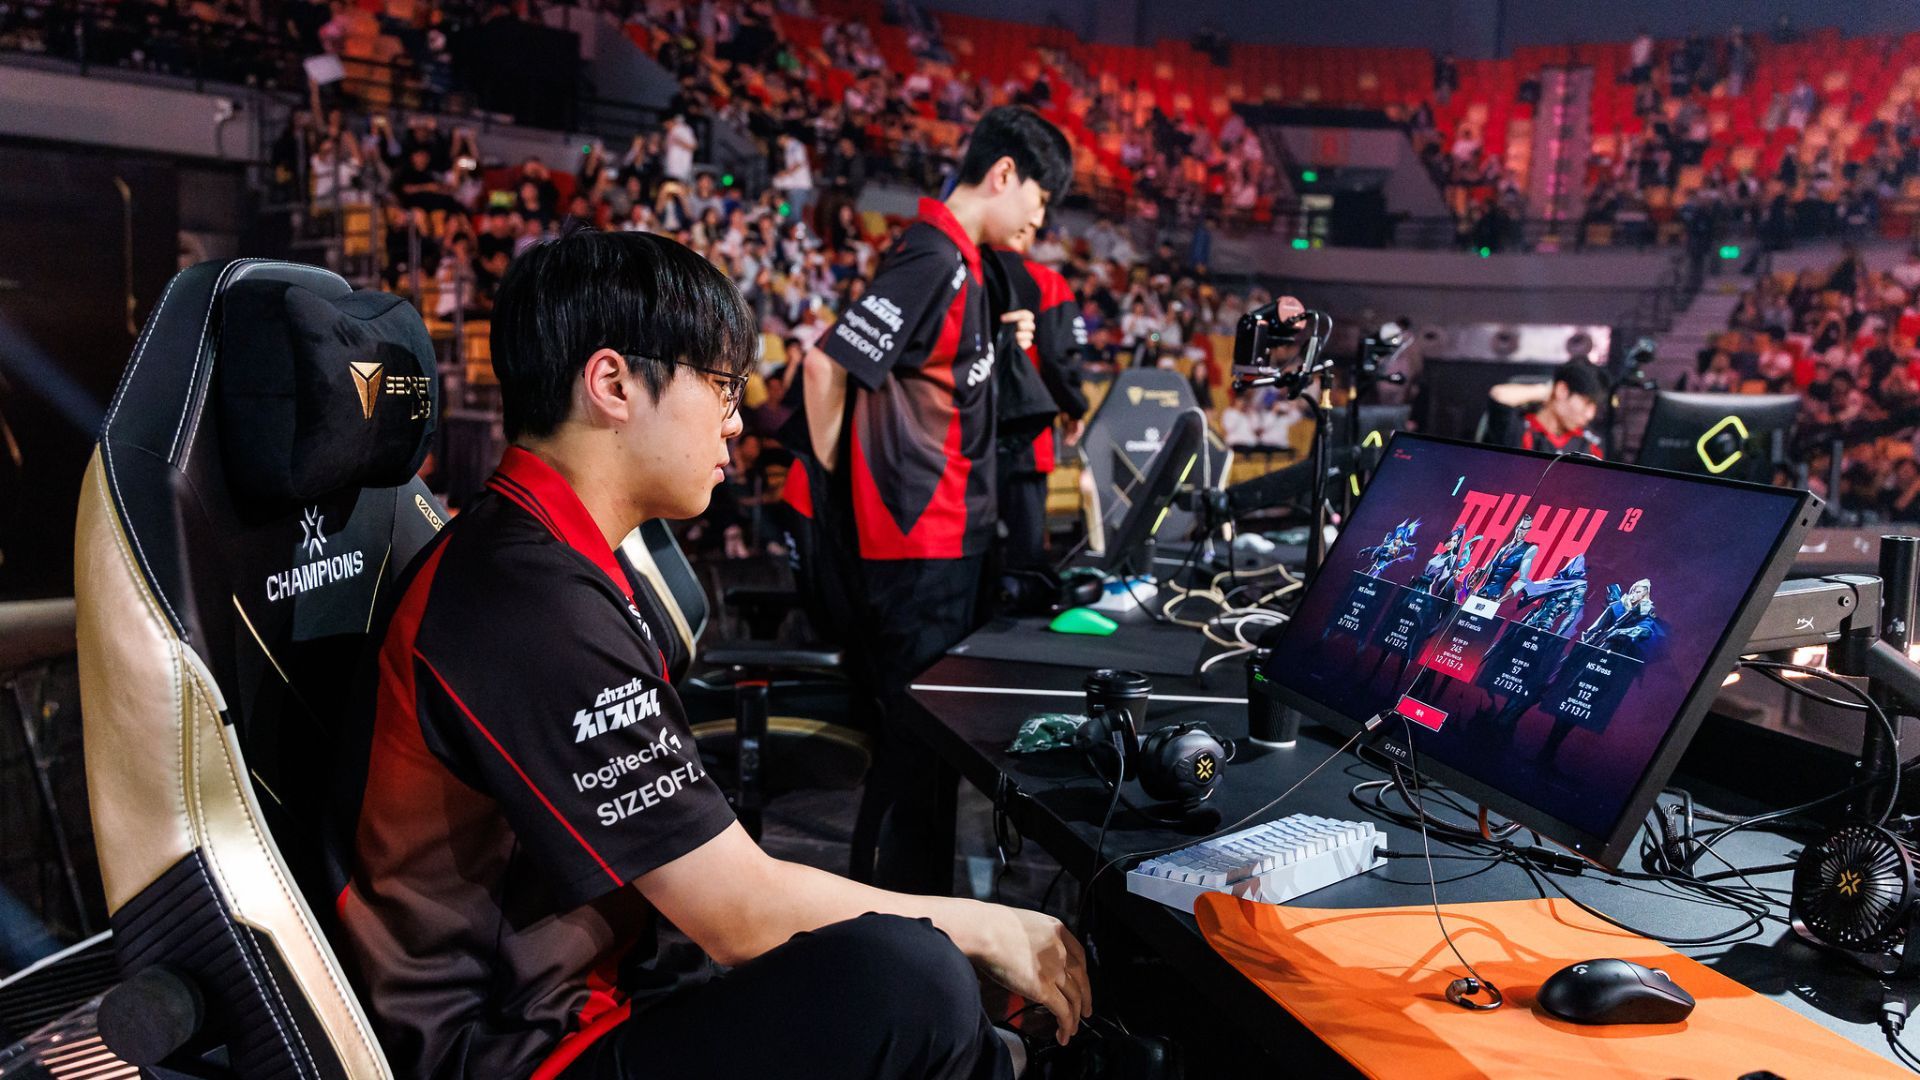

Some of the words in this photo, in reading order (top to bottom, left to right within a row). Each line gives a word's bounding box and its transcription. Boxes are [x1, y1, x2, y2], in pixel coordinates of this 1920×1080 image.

[386, 375, 431, 399] SECRET
[1451, 475, 1465, 496] 1
[1618, 507, 1644, 533] 13
[266, 550, 364, 602] CHAMPIONS
[1398, 624, 1409, 634] 113
[1463, 620, 1482, 632] Francis
[1450, 644, 1463, 654] 245
[1522, 640, 1531, 649] NS
[1511, 666, 1522, 675] 57
[1586, 661, 1596, 671] NS
[1594, 664, 1612, 676] Xross
[595, 677, 642, 708] chzzk
[1577, 689, 1592, 701] 112
[573, 688, 661, 743] 치지직
[1384, 743, 1407, 758] OMEN
[573, 742, 669, 793] logitech
